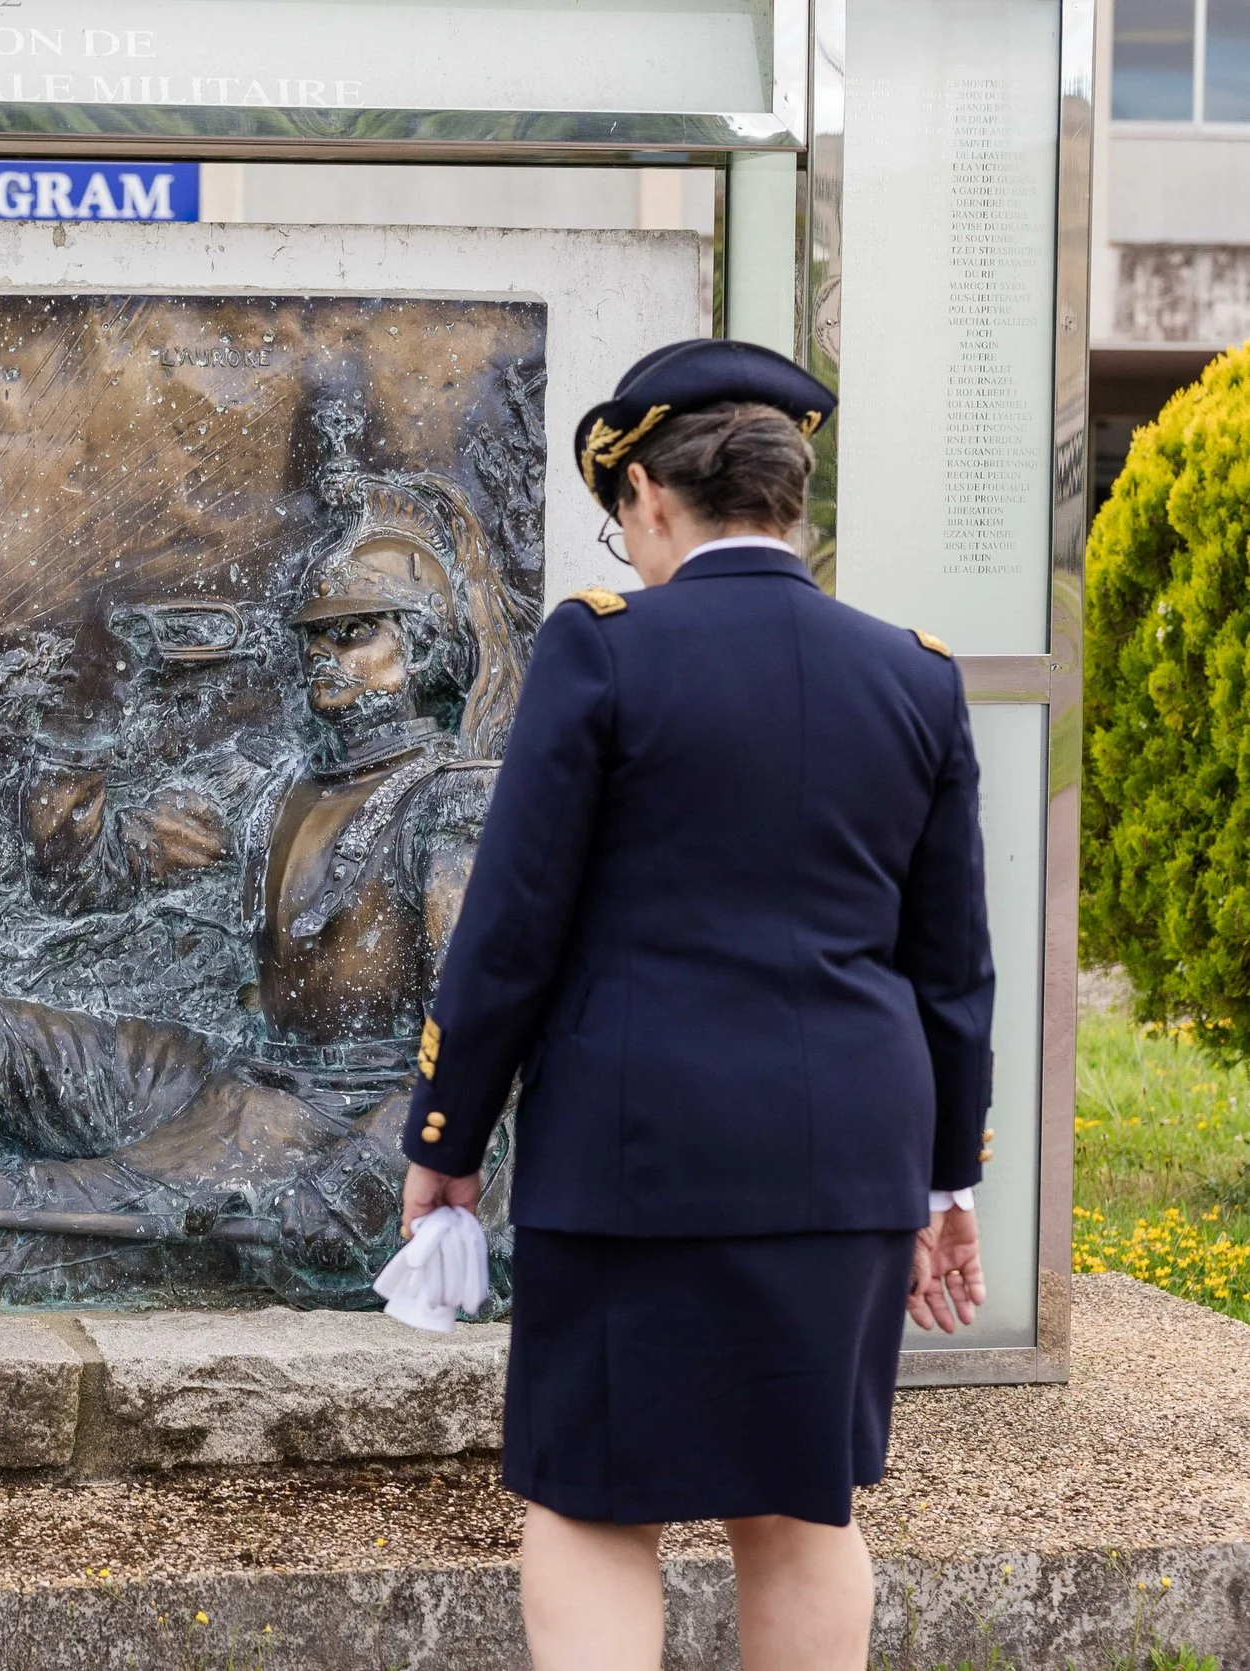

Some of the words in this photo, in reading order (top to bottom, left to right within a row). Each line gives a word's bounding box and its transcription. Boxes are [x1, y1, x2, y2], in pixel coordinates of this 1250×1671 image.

[83, 29, 157, 58] DE
[90, 75, 365, 107] MILITAIRE
[958, 140, 992, 148] SAINTE
[955, 152, 969, 160] DE
[971, 152, 1025, 160] LAFAYETTE
[960, 163, 972, 172] LA
[981, 175, 995, 183] DE
[959, 187, 993, 195] GARDE
[956, 199, 1005, 208] DERNIERE
[991, 211, 1030, 219] GUERRE
[984, 223, 999, 231] DU
[965, 235, 1014, 243] SOUVENIR
[965, 247, 977, 255] ET
[979, 247, 1040, 255] STRASBOURG
[998, 258, 1037, 267] BAYARD
[965, 270, 978, 279] DU
[981, 270, 997, 279] RIF
[949, 282, 984, 290] MAROC
[985, 282, 997, 290] ET
[950, 294, 1031, 302] OUS-LIEUTENANT
[948, 306, 967, 314] POL
[969, 306, 1012, 314] LAPEYRE
[993, 318, 1037, 326] GALLIENI
[966, 330, 993, 338] FOCH
[959, 342, 999, 350] MANGIN
[961, 353, 997, 361] JOFFRE
[961, 365, 1013, 373] TAFILALET
[958, 377, 1014, 385] BOURNAZEL
[956, 389, 974, 397] ROI
[975, 389, 1011, 397] ALBERT
[964, 401, 1021, 409] ALEXANDRE
[993, 412, 1033, 421] LYAUTEY
[983, 424, 1028, 432] INCONNU
[969, 436, 980, 444] ET
[982, 436, 1022, 444] VERDUN
[964, 448, 1006, 456] GRANDE
[966, 483, 980, 491] DE
[982, 483, 1031, 491] FOUCAULT
[959, 495, 973, 503] DE
[975, 495, 1026, 503] PROVENCE
[948, 507, 1004, 515] LIBERATION
[977, 530, 1014, 538] TUNISIE
[968, 542, 980, 550] ET
[982, 542, 1015, 550] SAVOIE
[959, 554, 969, 562] 18
[970, 554, 991, 562] JUIN
[962, 565, 976, 573] AU
[978, 565, 1022, 573] DRAPEAU
